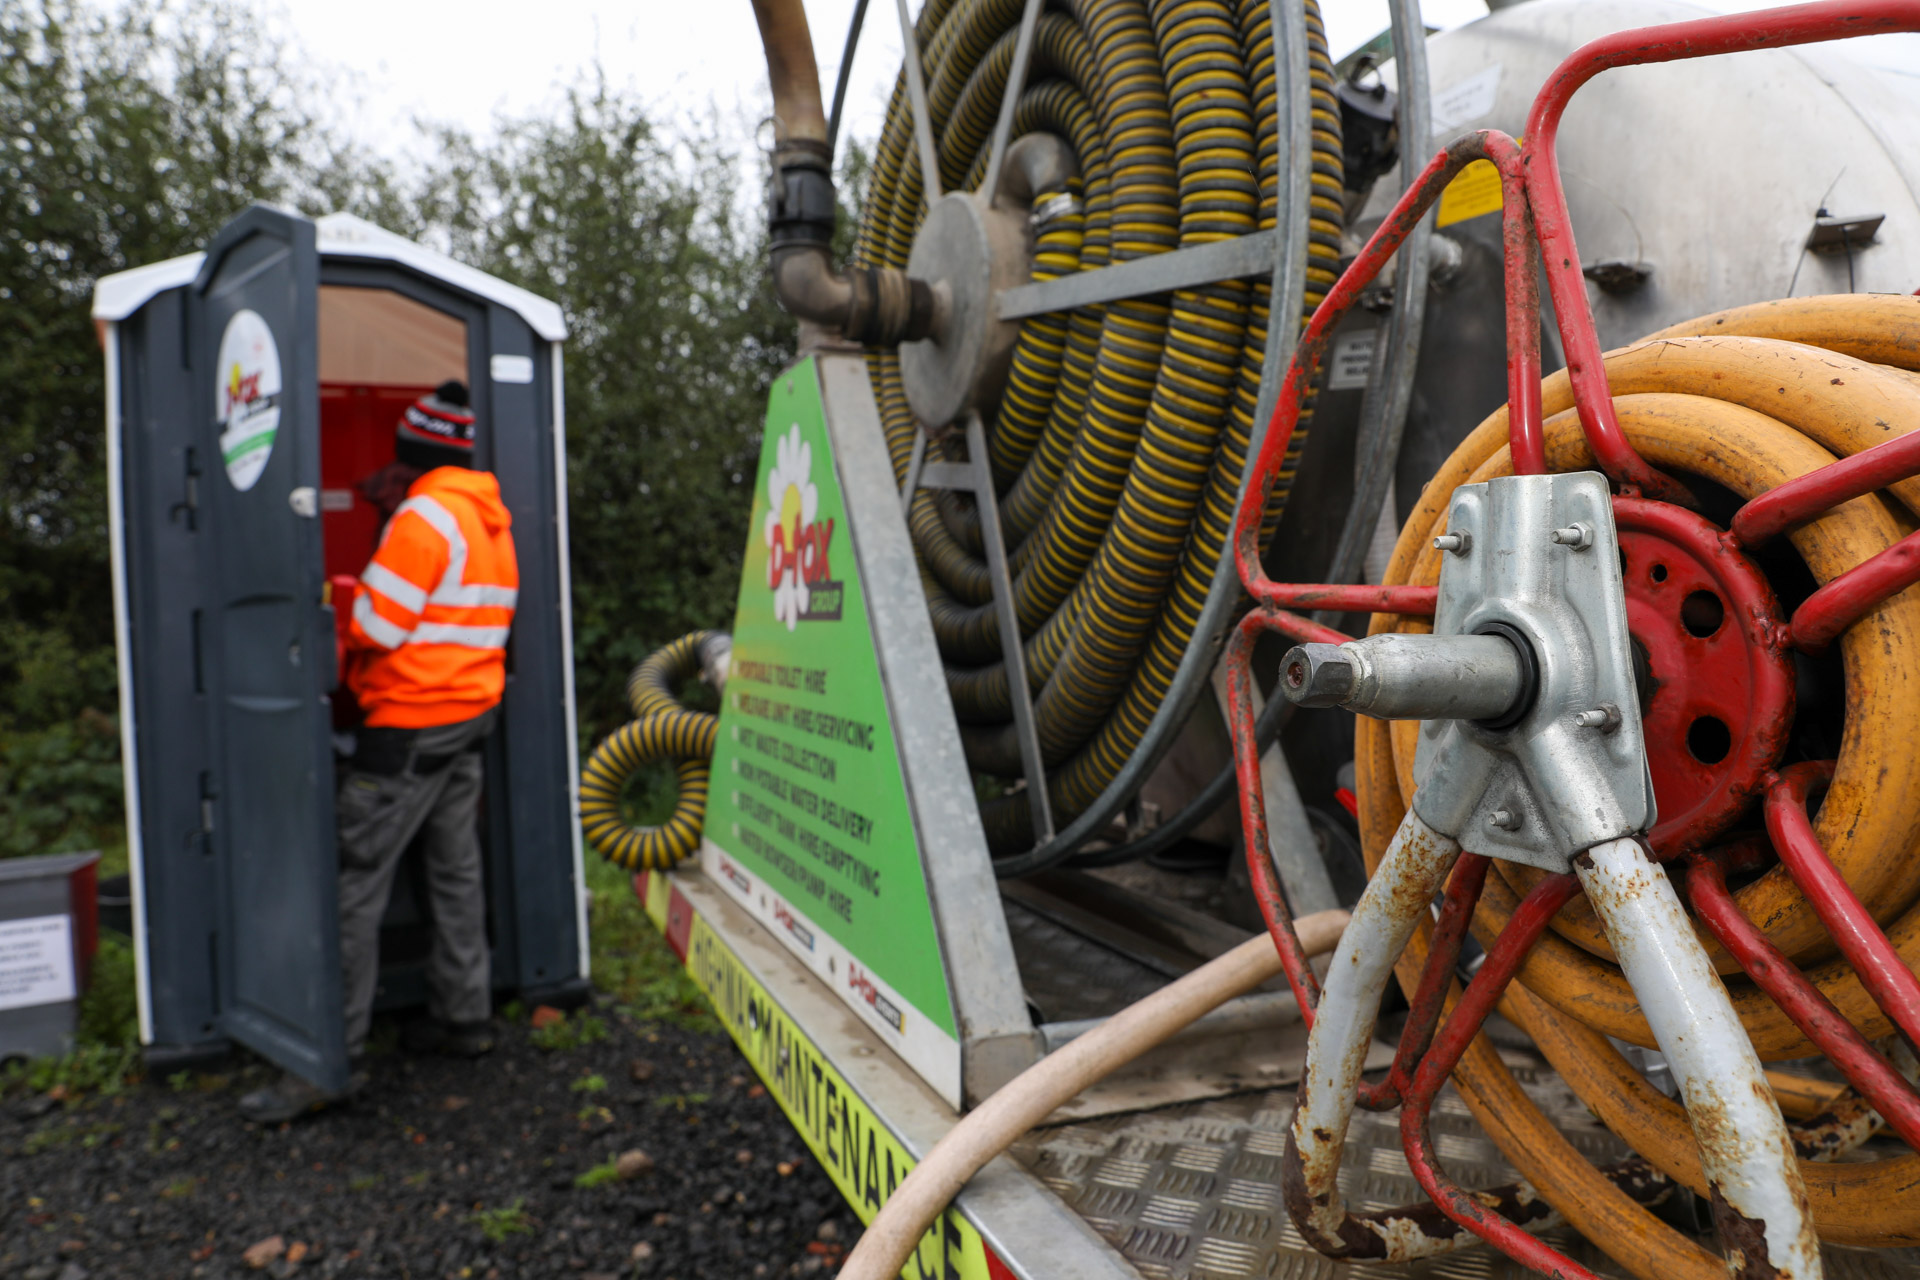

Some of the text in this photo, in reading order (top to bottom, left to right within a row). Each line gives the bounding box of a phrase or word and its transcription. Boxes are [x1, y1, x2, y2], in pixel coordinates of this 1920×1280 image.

[804, 667, 828, 695] HIRE
[782, 736, 837, 784] COLLECTION
[790, 778, 819, 818] WATER
[821, 791, 875, 846] DELIVERY
[828, 882, 854, 925] HIRE
